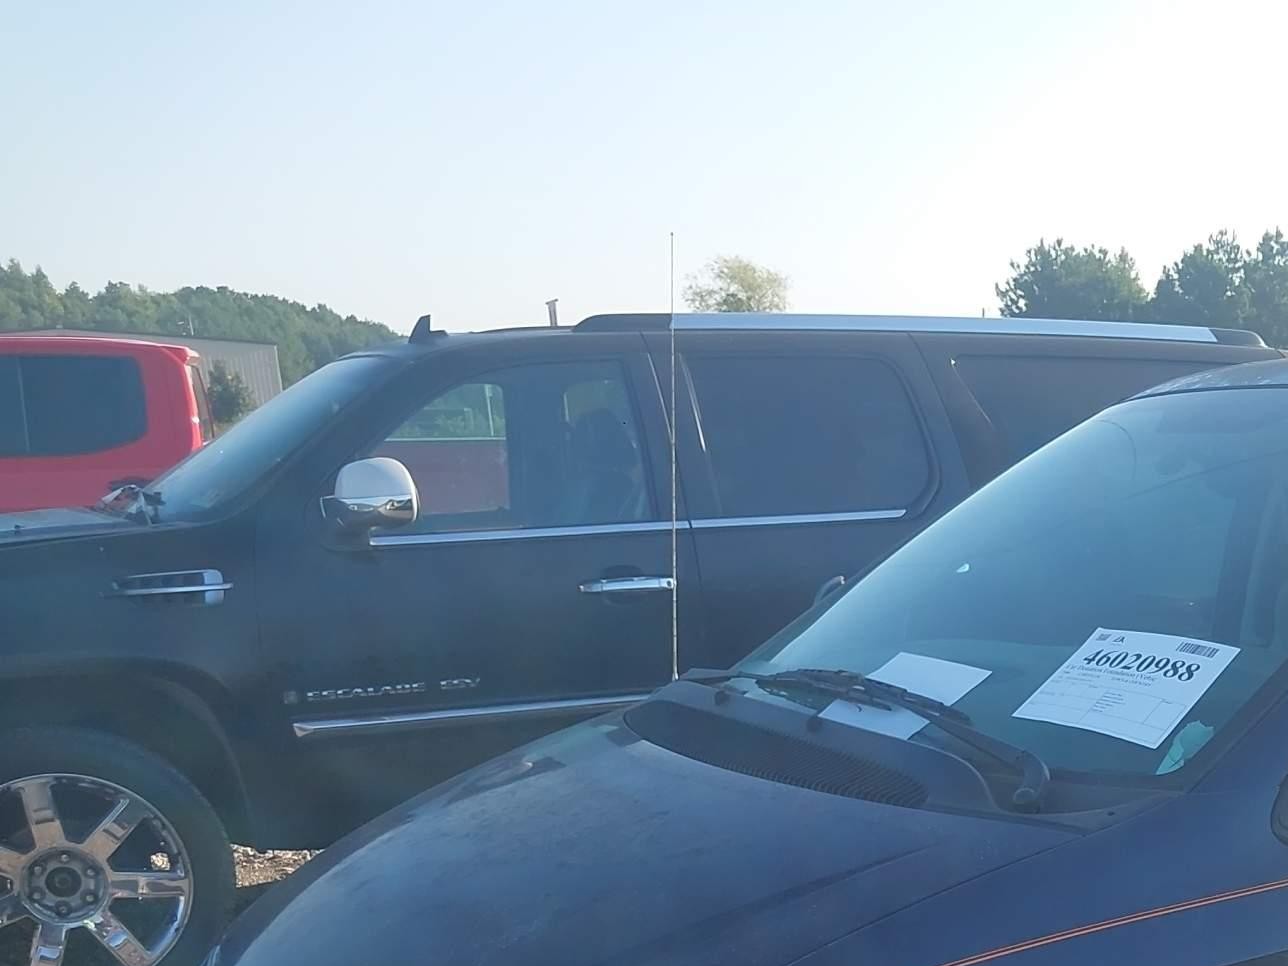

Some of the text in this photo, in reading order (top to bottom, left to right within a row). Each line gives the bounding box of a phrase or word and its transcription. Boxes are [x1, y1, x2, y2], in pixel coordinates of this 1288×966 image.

[1083, 648, 1201, 682] 46020988
[306, 677, 480, 701] ESCALADE ESV
